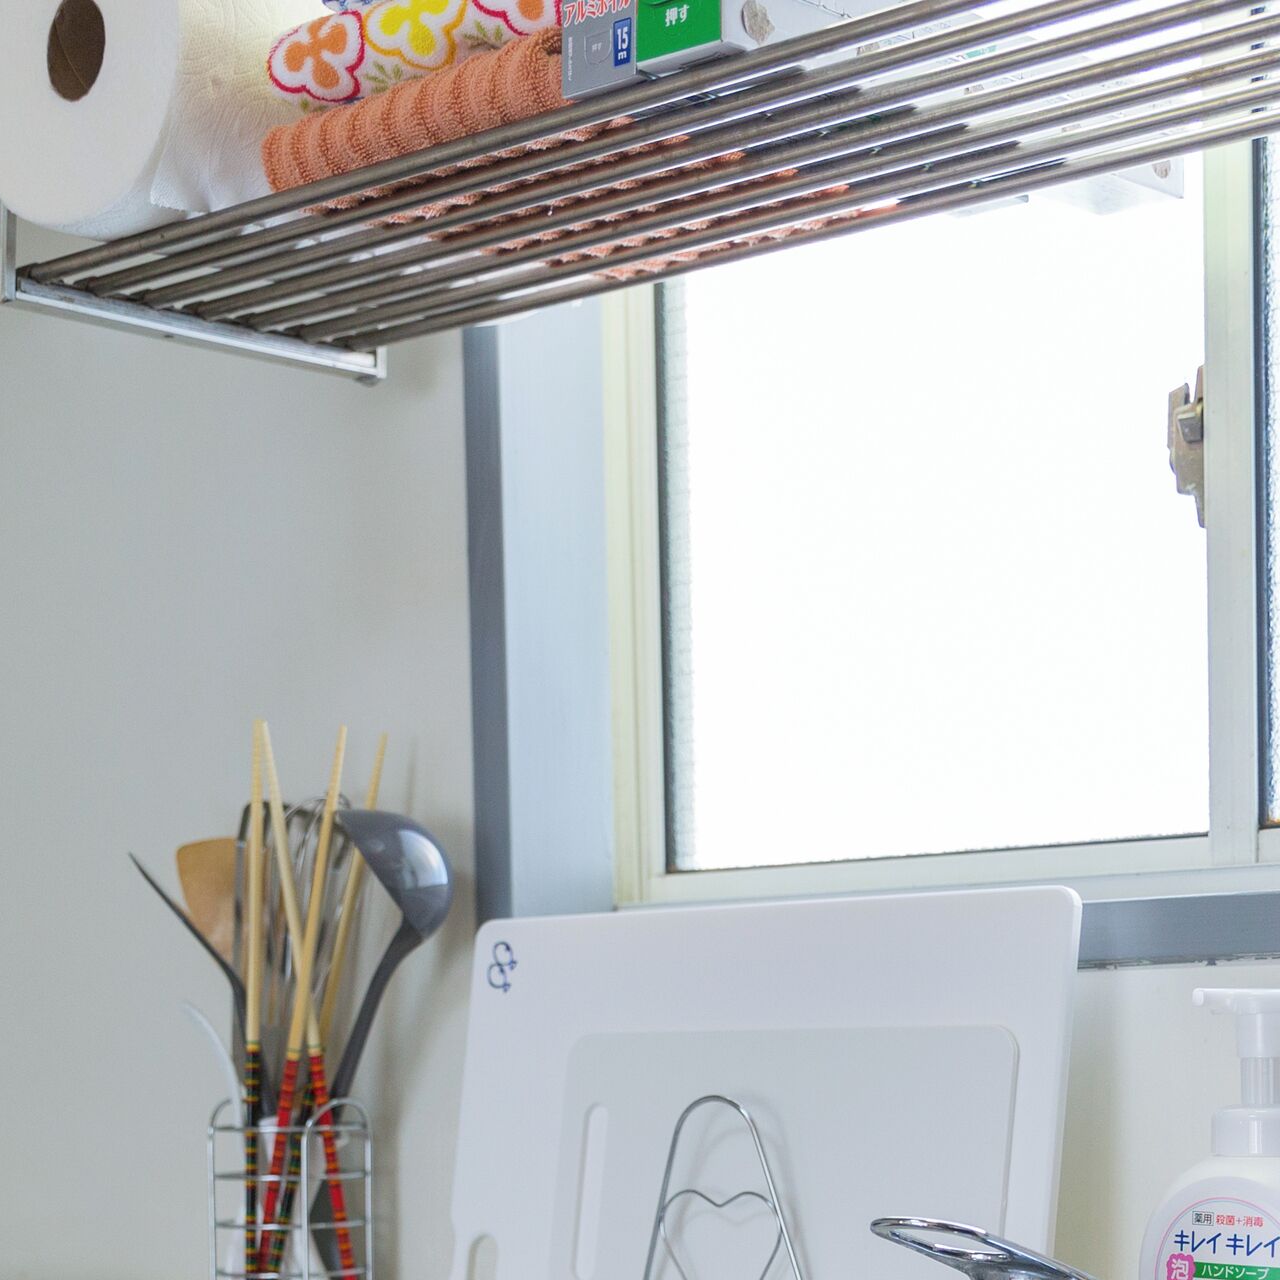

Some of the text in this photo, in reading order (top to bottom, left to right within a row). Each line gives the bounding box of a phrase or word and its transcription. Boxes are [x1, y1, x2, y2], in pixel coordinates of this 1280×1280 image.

[665, 4, 690, 27] 押す
[617, 26, 629, 50] 15
[618, 51, 627, 60] m
[1194, 1213, 1212, 1225] 薬用
[1171, 1258, 1270, 1280] 泡 ハンドソープ
